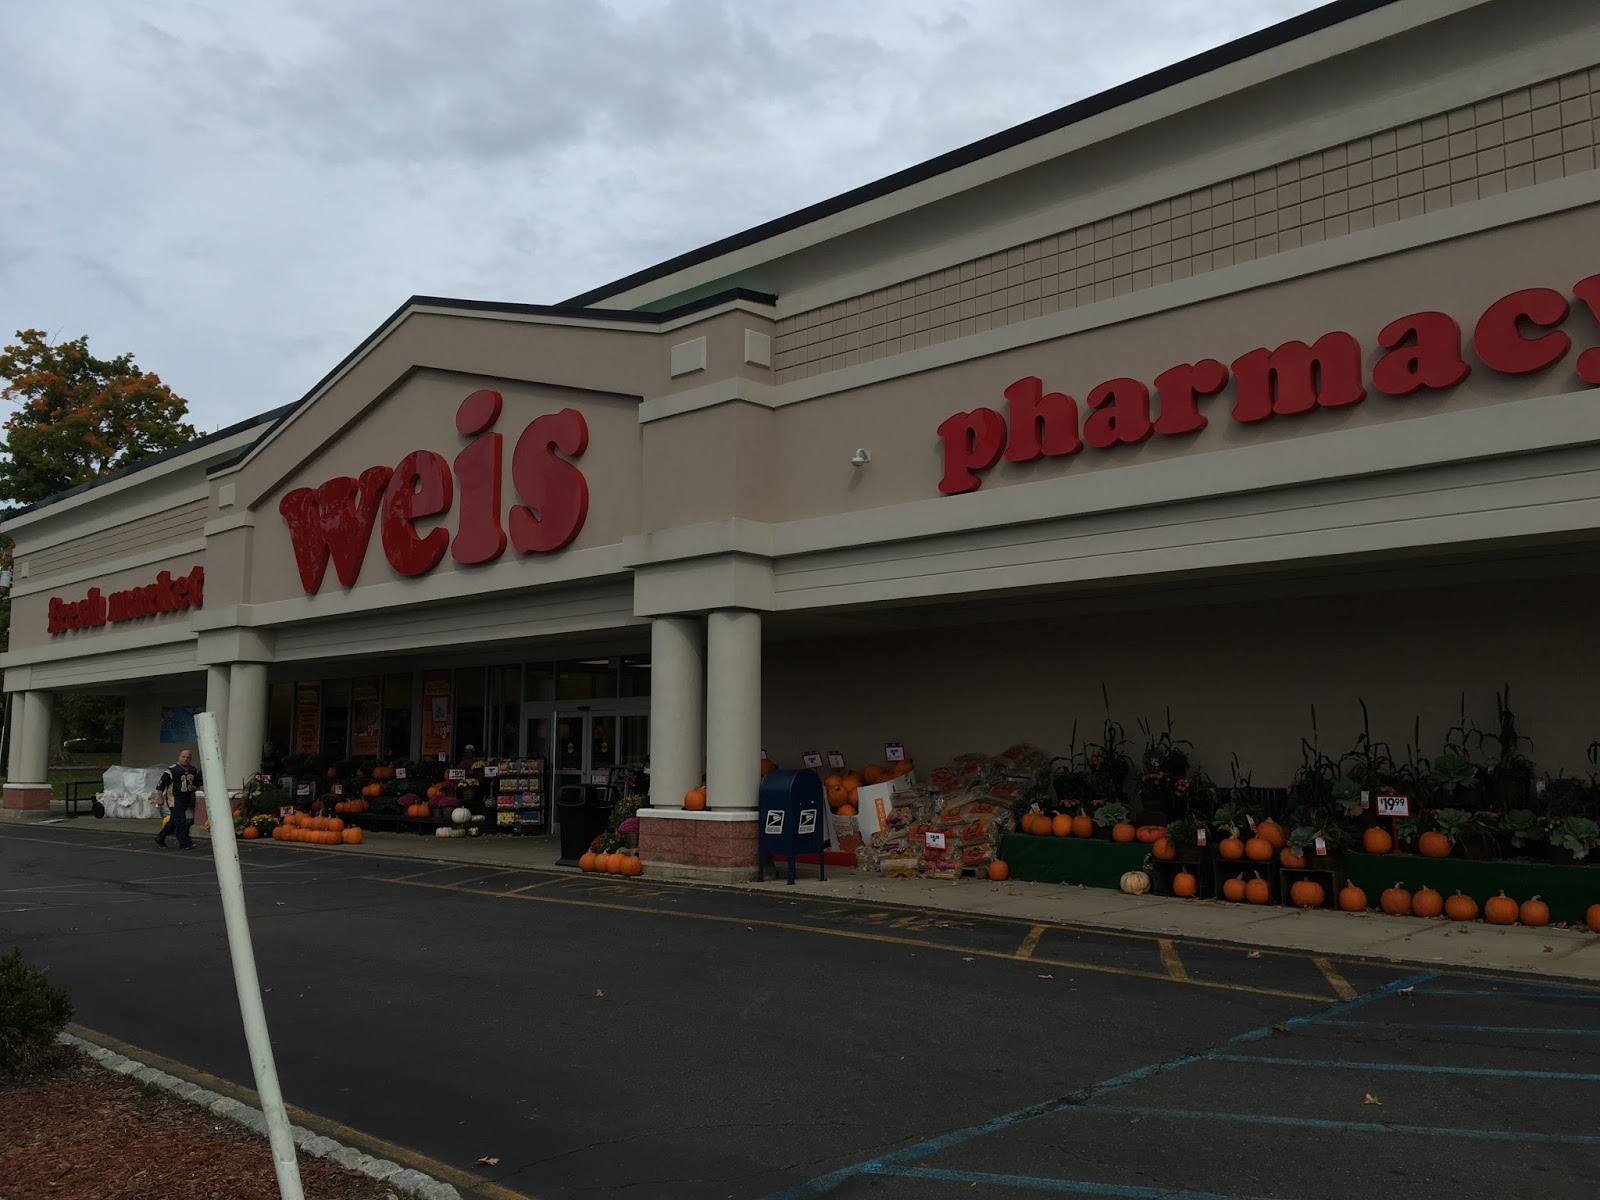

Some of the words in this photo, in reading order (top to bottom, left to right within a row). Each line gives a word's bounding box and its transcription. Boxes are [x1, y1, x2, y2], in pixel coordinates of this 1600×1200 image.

[279, 389, 589, 594] weis
[47, 587, 107, 634] fresh
[107, 565, 204, 621] market
